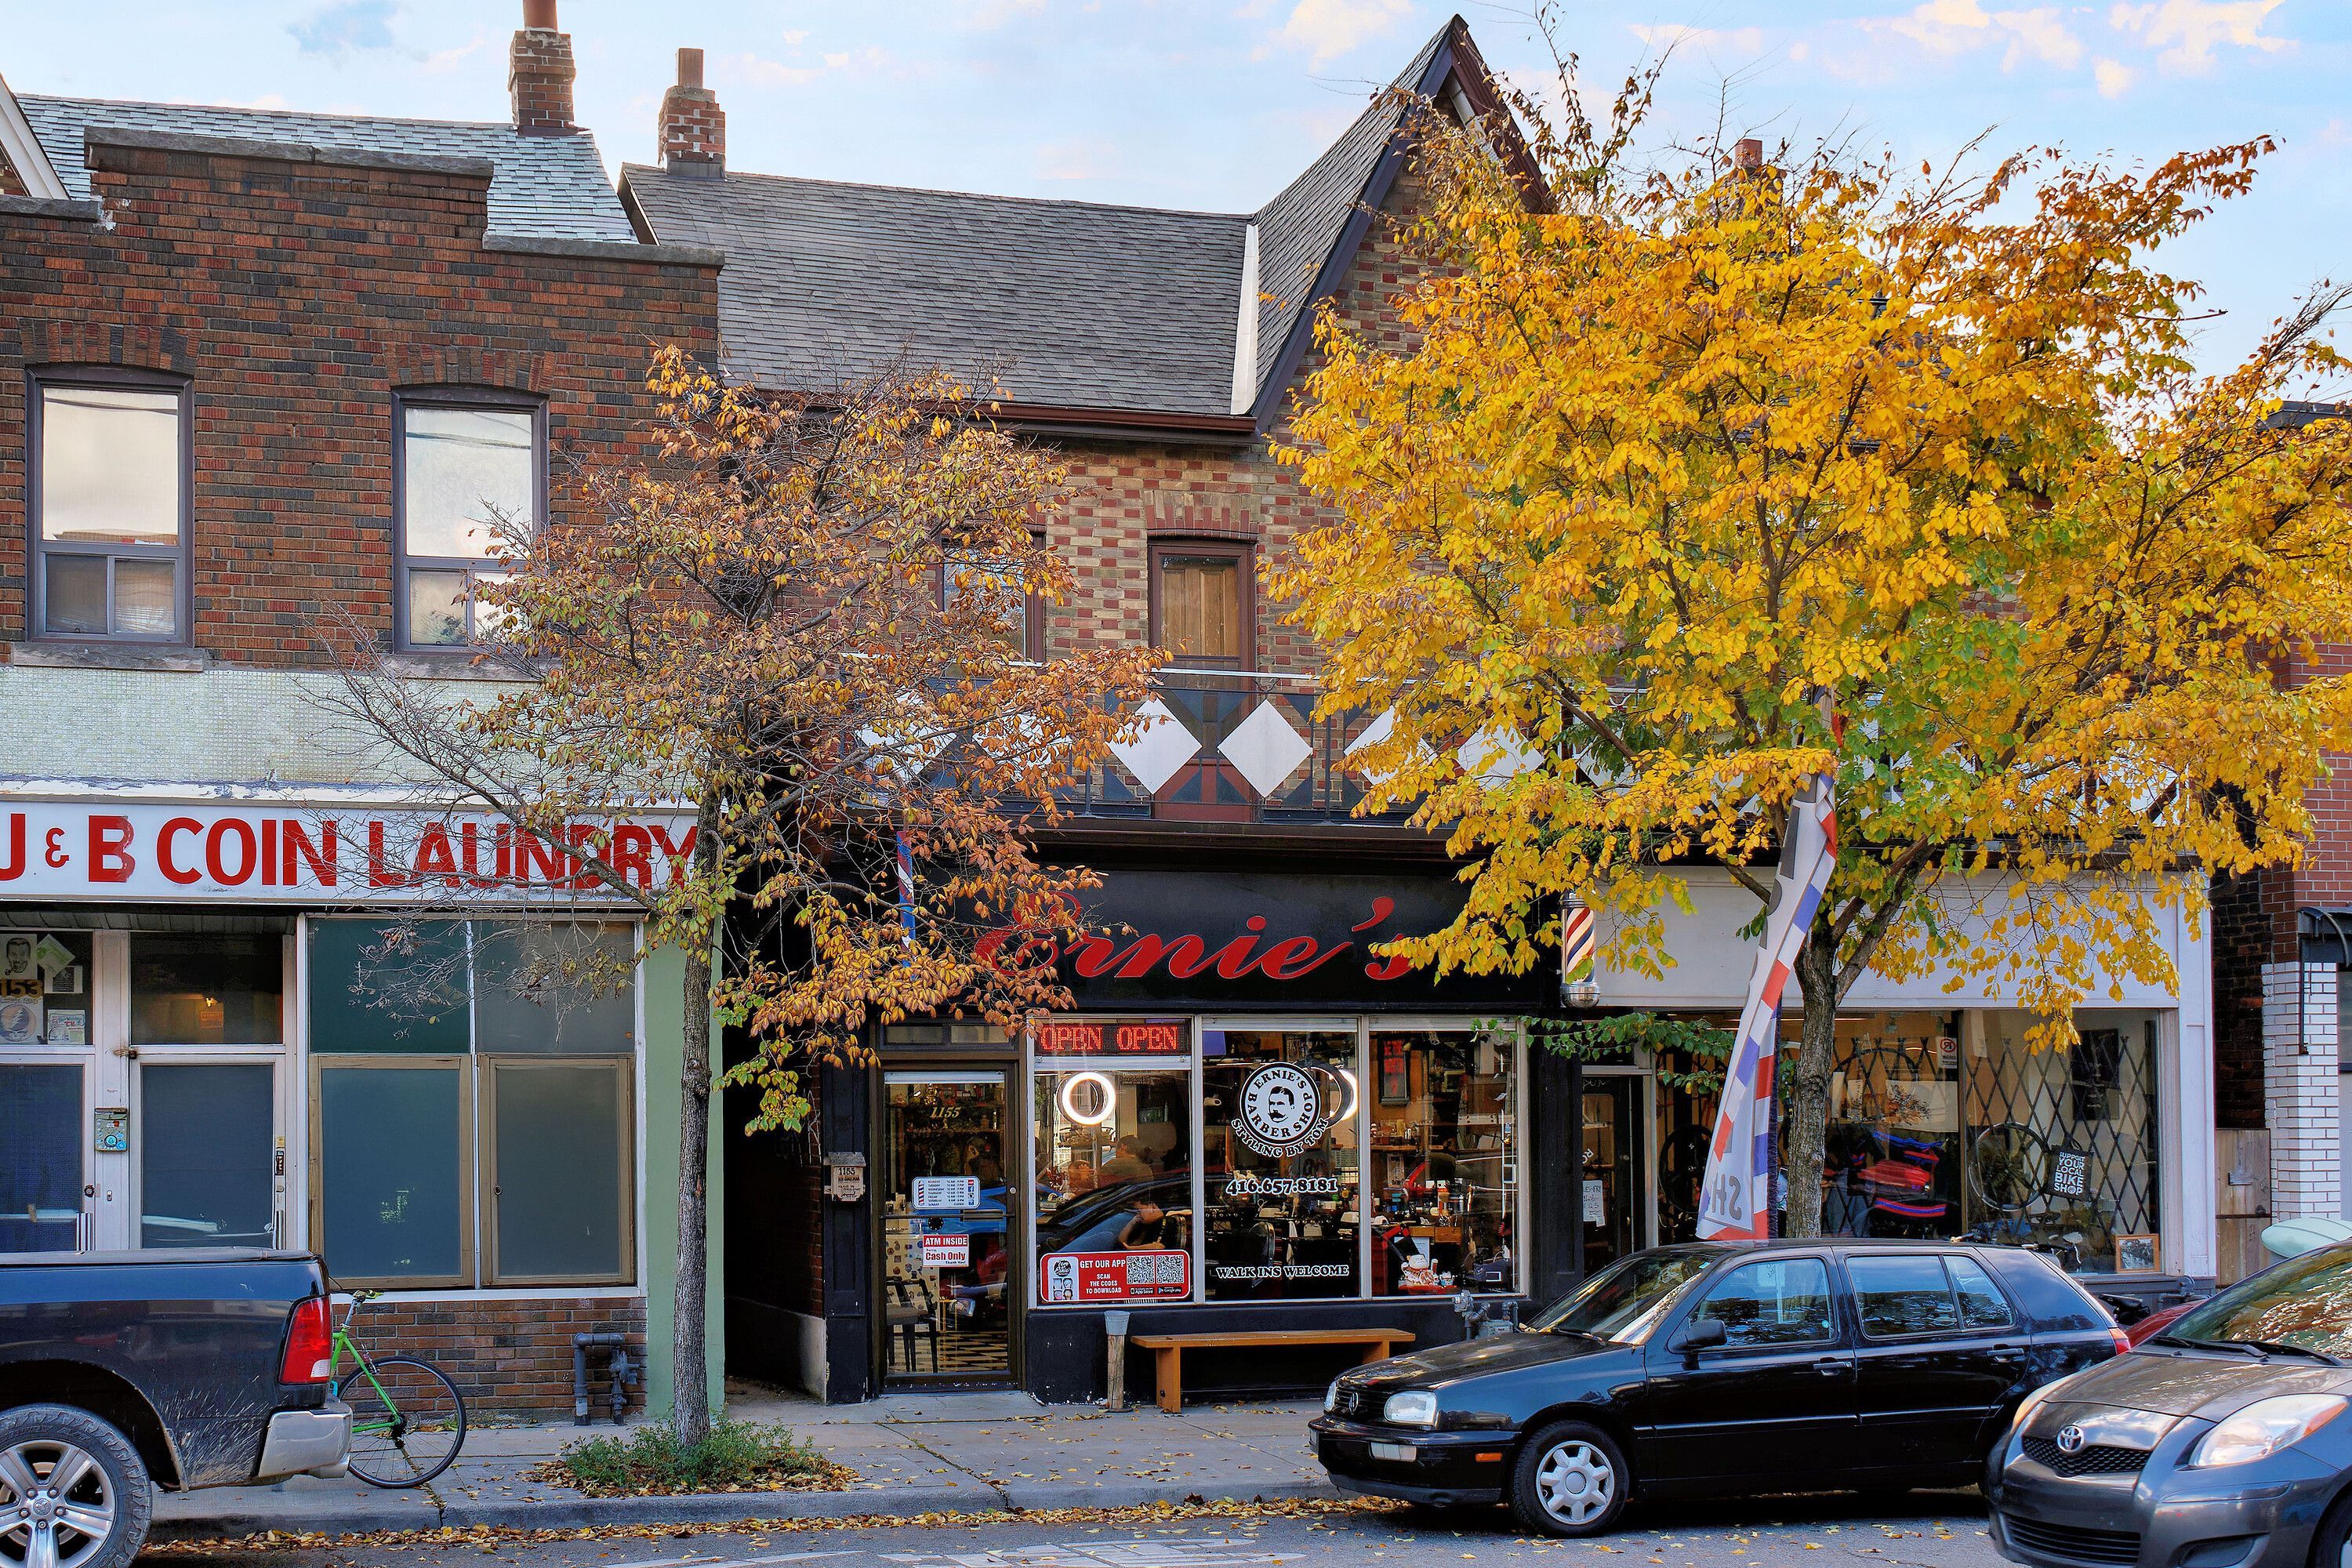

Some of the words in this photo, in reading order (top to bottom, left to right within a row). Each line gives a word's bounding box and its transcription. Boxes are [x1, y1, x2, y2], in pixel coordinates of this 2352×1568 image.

[0, 813, 26, 881] J
[45, 827, 70, 868] &
[89, 815, 136, 883] B
[156, 817, 337, 887] COIN
[368, 821, 698, 890] LAUNDRY
[974, 890, 1421, 980] Ernie's
[1040, 1026, 1102, 1051] OPEN
[1116, 1026, 1178, 1051] OPEN
[1253, 1069, 1307, 1090] ERNIE'S
[930, 1106, 961, 1118] 1155
[1247, 1092, 1291, 1137] BARBER
[1293, 1092, 1312, 1132] SHOP
[1231, 1118, 1283, 1158] STYLING
[1286, 1142, 1304, 1156] BY
[1305, 1117, 1329, 1147] TOM
[2059, 1152, 2085, 1162] SUPPORT
[2059, 1156, 2085, 1170] YOUR
[2056, 1165, 2084, 1177] LOCAL
[2054, 1171, 2084, 1187] BIKE
[1226, 1178, 1338, 1196] 416.657.8181
[2054, 1182, 2083, 1196] SHOP
[948, 1252, 965, 1261] Only
[1080, 1260, 1094, 1269] GET
[1112, 1259, 1126, 1268] APP
[1216, 1266, 1255, 1279] WALK
[1258, 1266, 1282, 1278] INS
[1283, 1265, 1349, 1277] WELCOME
